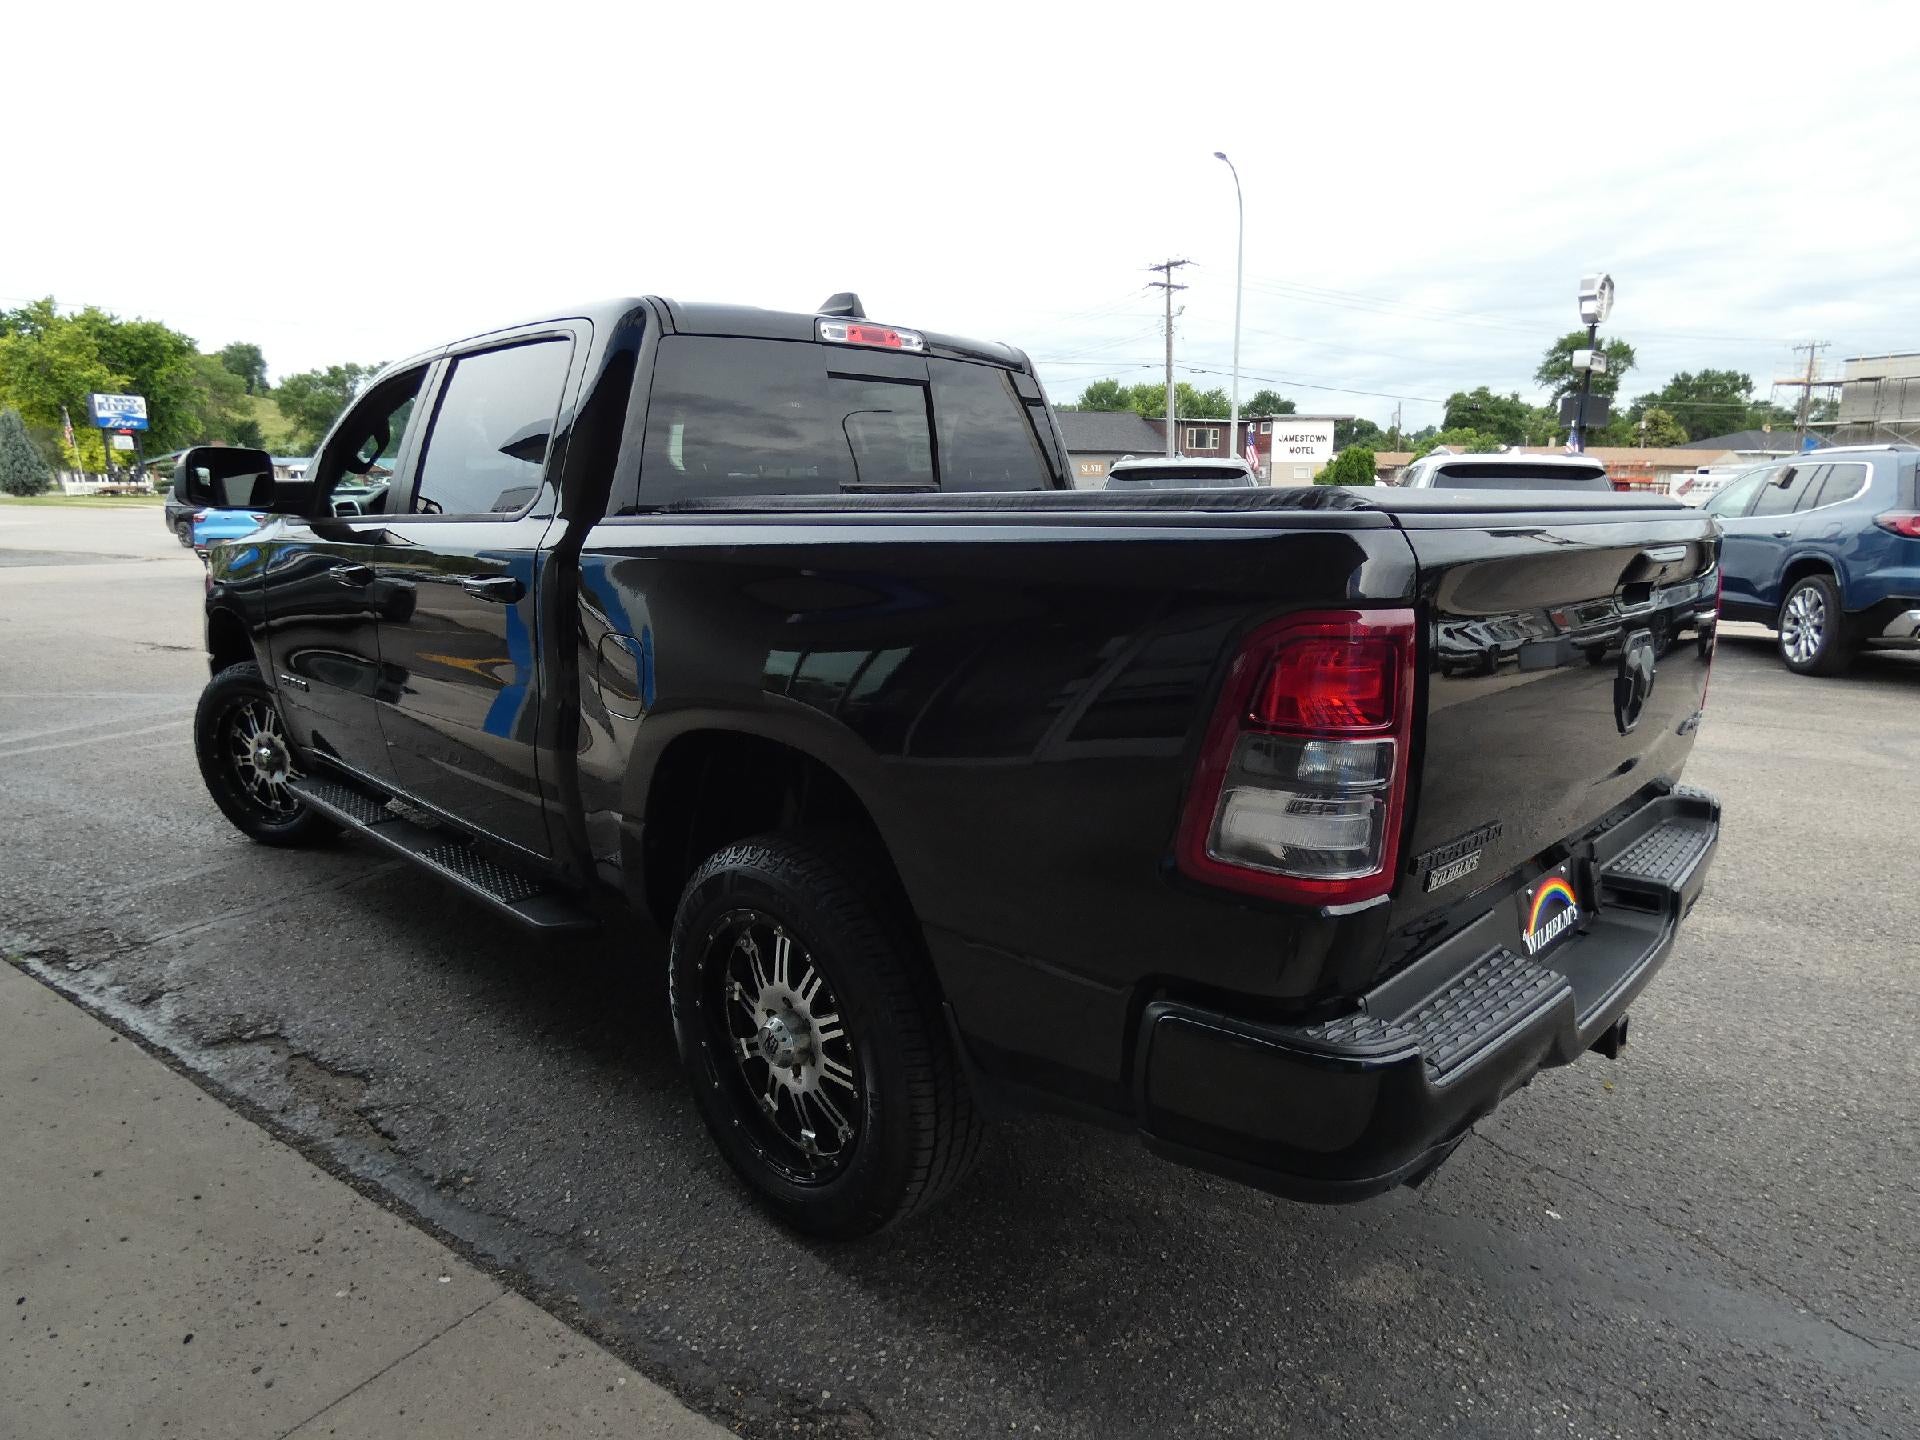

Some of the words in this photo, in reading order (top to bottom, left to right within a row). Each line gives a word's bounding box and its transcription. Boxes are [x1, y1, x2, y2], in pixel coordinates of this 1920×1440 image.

[1278, 434, 1328, 443] JAMESTOWN
[1289, 446, 1315, 455] MOTEL
[1522, 899, 1578, 955] WILHELM'S
